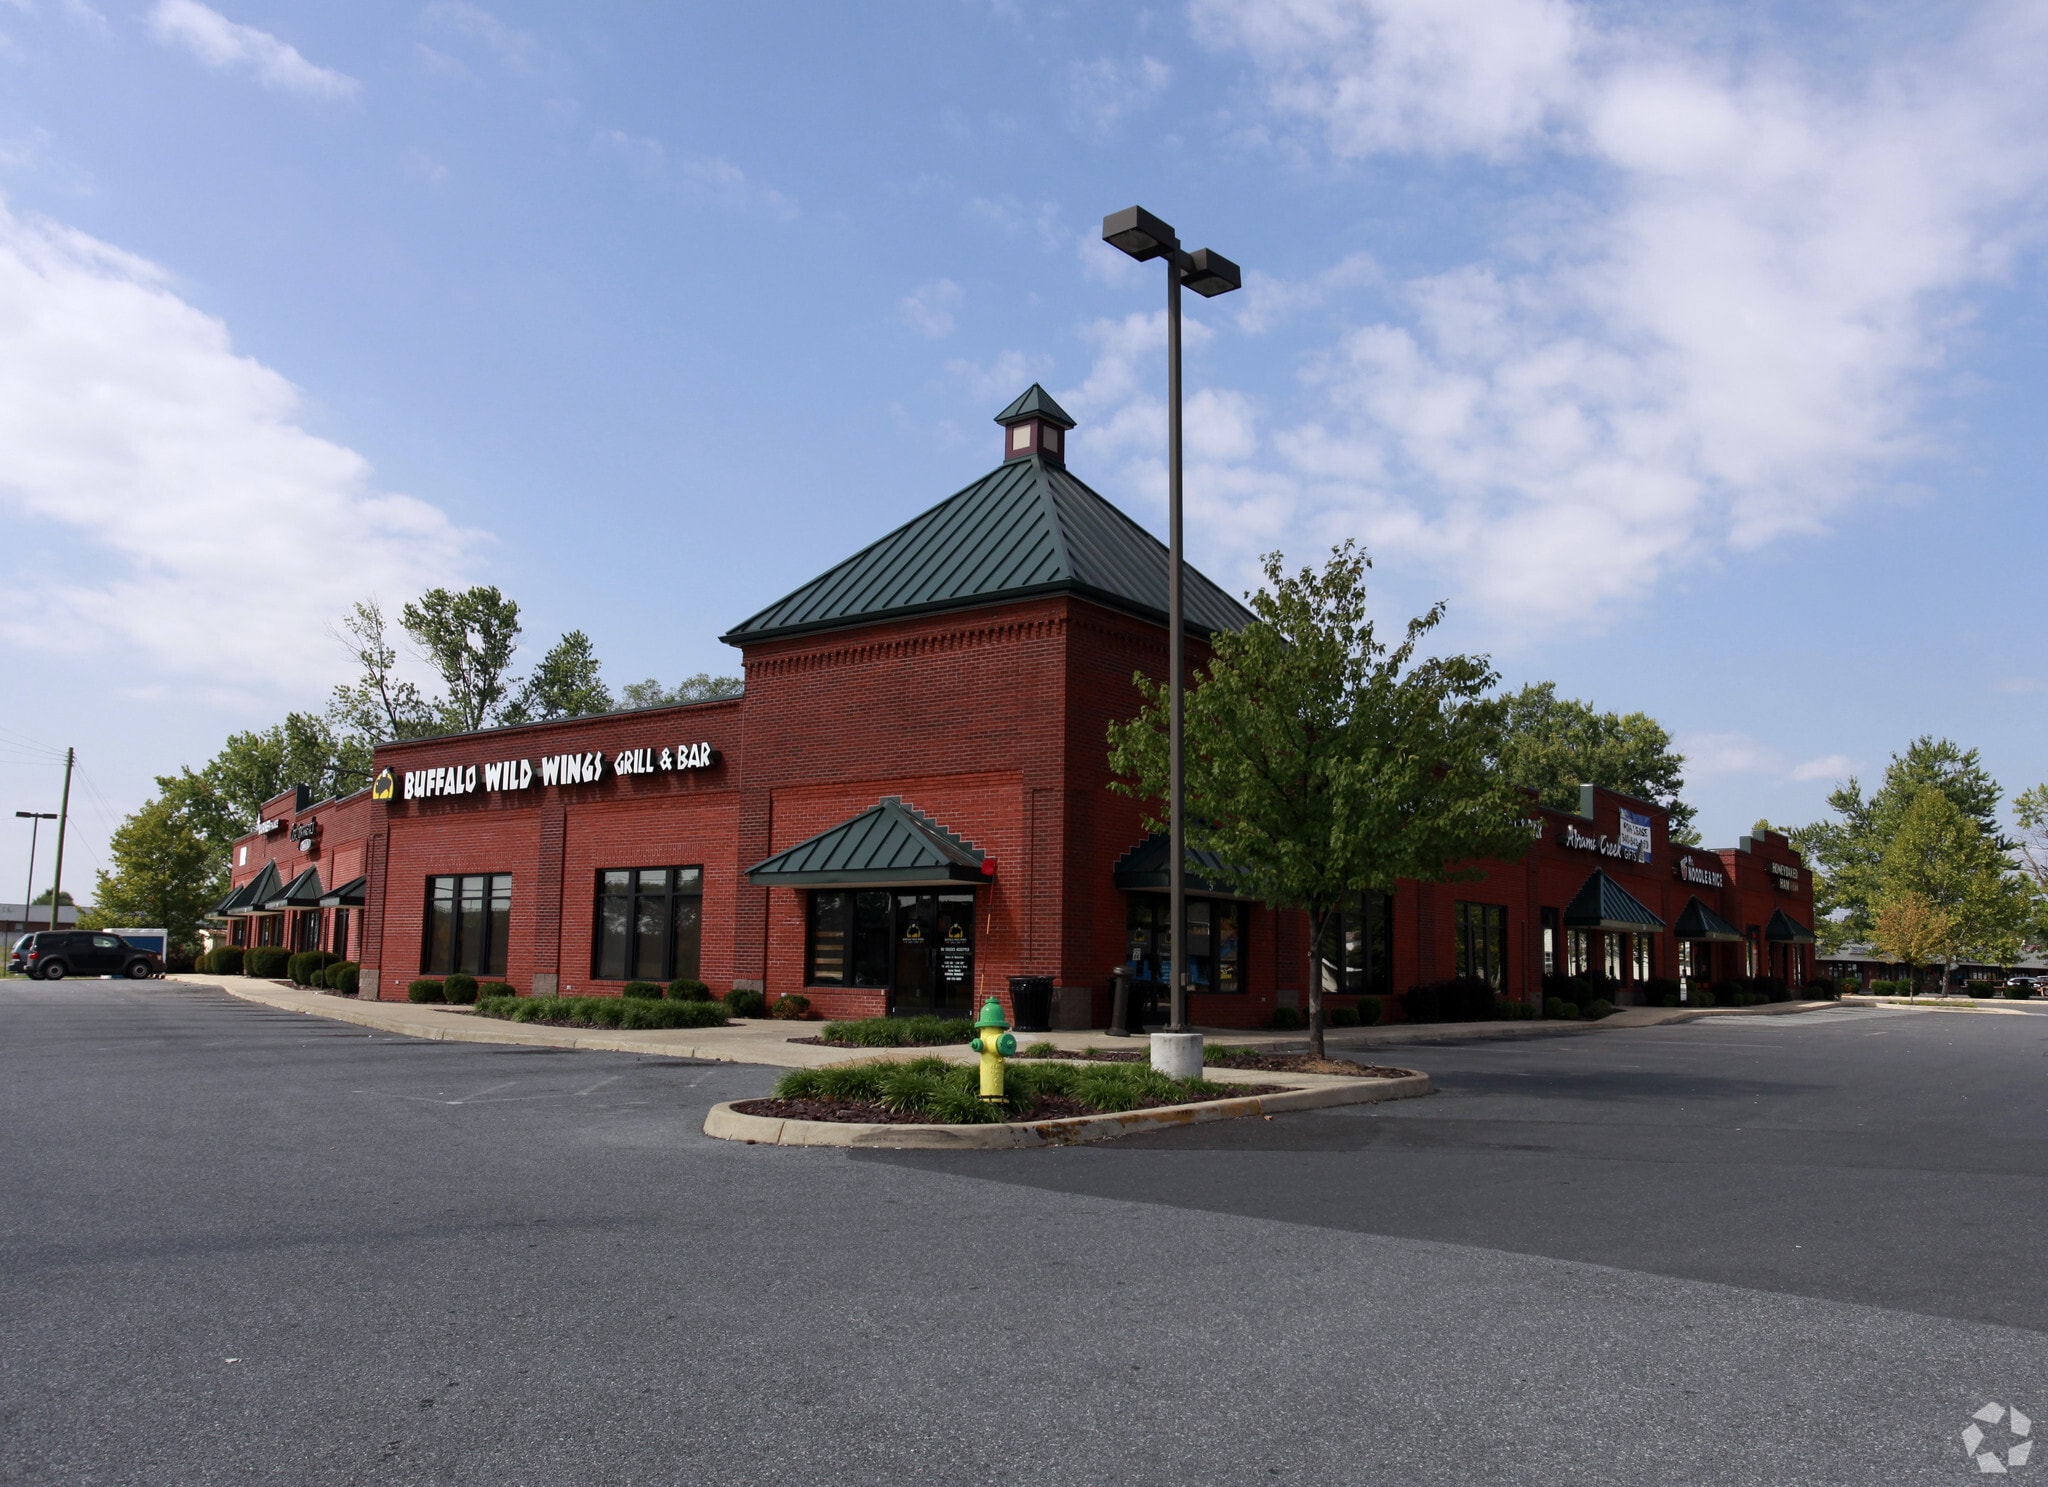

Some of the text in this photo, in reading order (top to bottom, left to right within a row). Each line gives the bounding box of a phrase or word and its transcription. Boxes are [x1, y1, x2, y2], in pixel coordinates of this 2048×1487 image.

[404, 741, 711, 800] BUFFALO WILD WINGS GRILL & BAR
